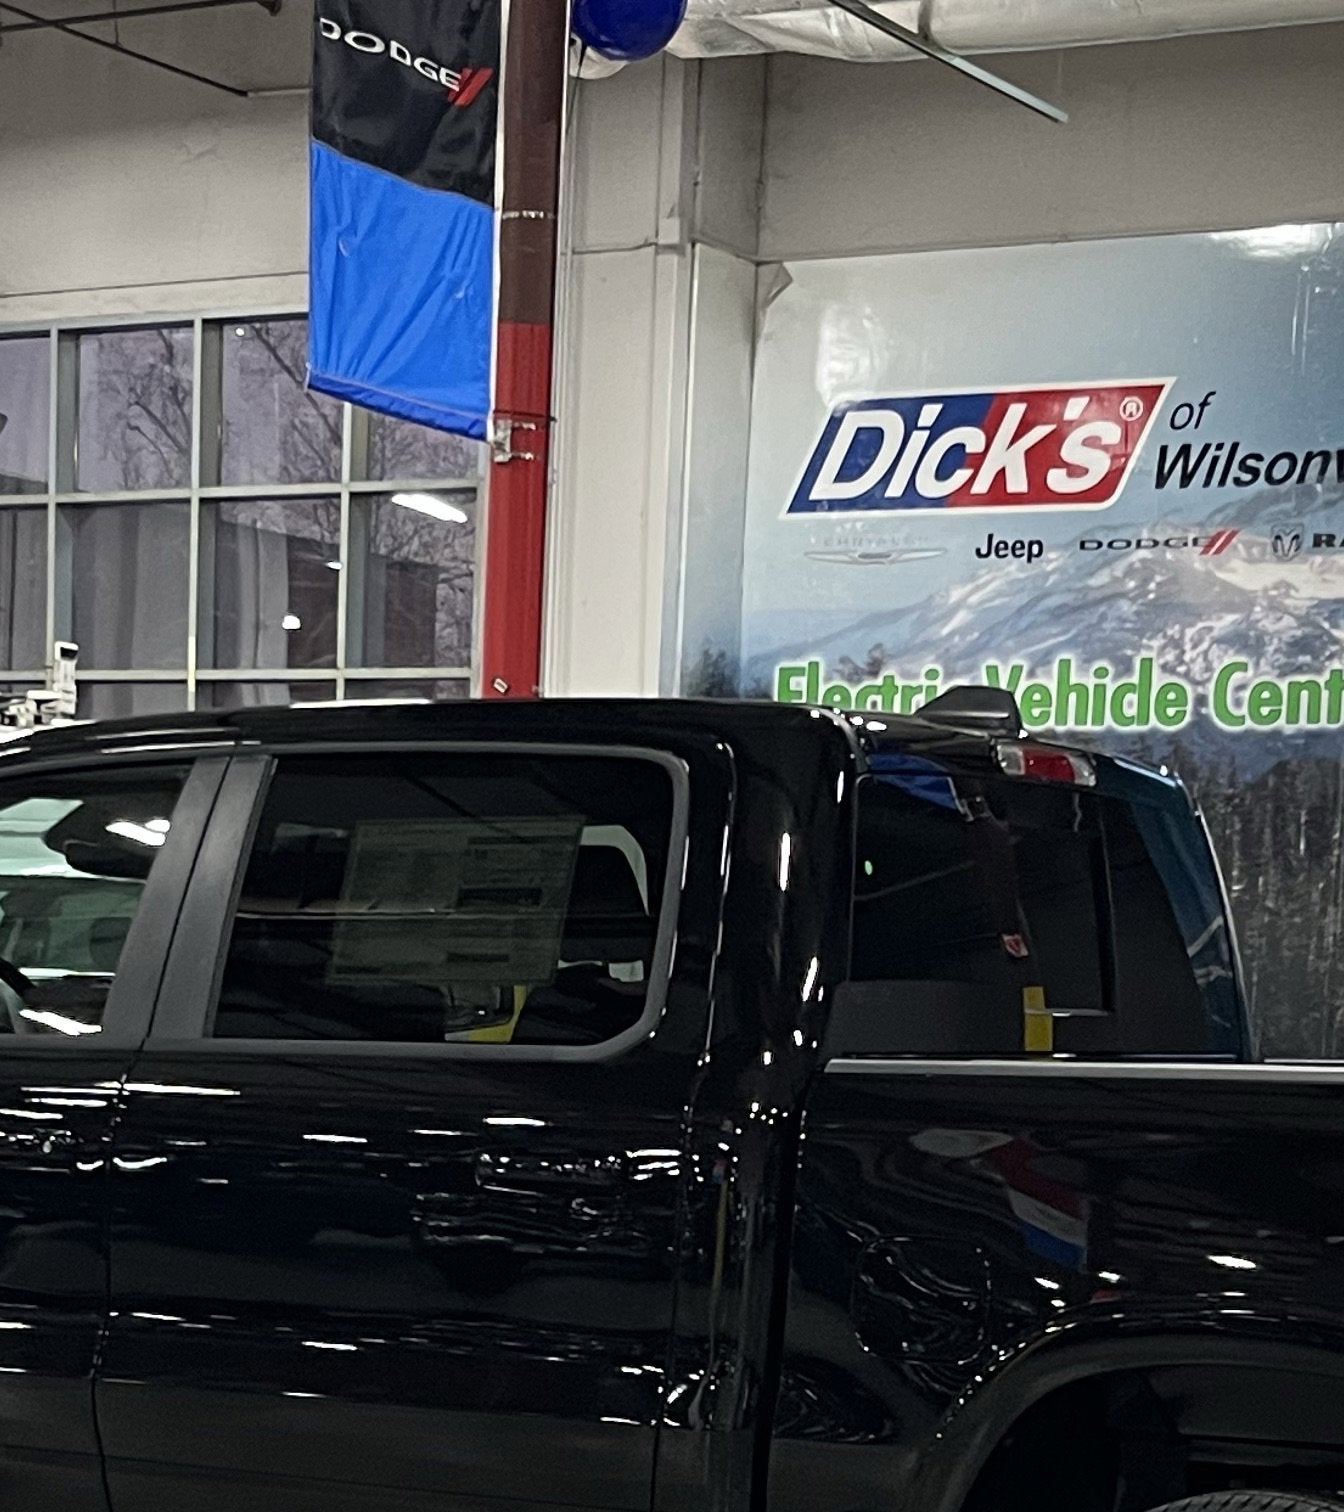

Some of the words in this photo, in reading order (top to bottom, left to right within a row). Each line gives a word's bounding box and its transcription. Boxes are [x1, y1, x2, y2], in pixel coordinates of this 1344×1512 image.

[320, 17, 462, 92] DODGE
[809, 396, 1123, 500] Dick's
[1169, 391, 1217, 430] of
[975, 534, 1043, 562] Jeep
[1079, 536, 1204, 552] DODGE
[777, 660, 940, 713] Electri
